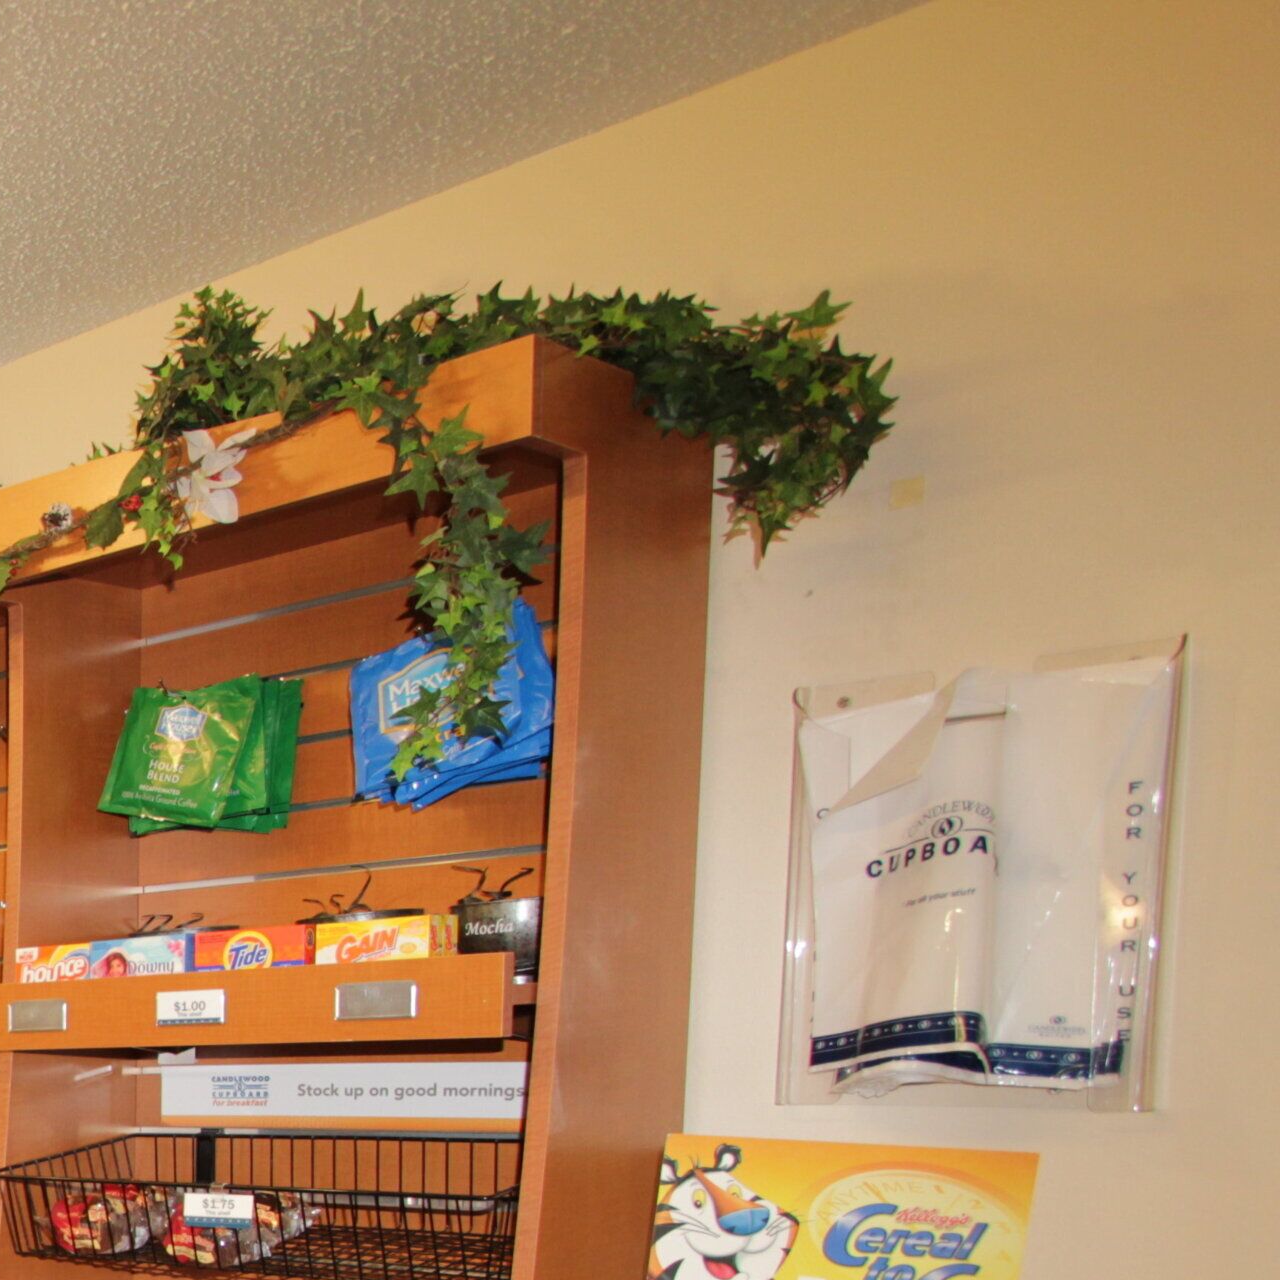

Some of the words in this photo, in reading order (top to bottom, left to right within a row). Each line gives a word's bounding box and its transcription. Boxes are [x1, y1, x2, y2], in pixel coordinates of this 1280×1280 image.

[149, 759, 185, 773] HOUSE
[147, 771, 180, 783] BLEND
[1126, 780, 1143, 840] FOR
[865, 834, 996, 878] CUPBOA
[1121, 871, 1139, 952] YOUR
[464, 917, 514, 937] Mocha
[230, 945, 267, 969] Tide
[22, 957, 89, 983] bounce
[128, 960, 175, 975] Downy
[173, 1000, 207, 1014] $1.00
[1117, 984, 1136, 1042] USE
[211, 1075, 270, 1083] CANDLEWOOD
[212, 1091, 269, 1099] CUPBOARD
[297, 1082, 340, 1098] Stock
[344, 1087, 364, 1101] up
[369, 1087, 389, 1098] on
[394, 1083, 438, 1101] good
[226, 1099, 268, 1107] breakfast
[202, 1198, 235, 1210] $1.75
[822, 1203, 988, 1267] Cereal
